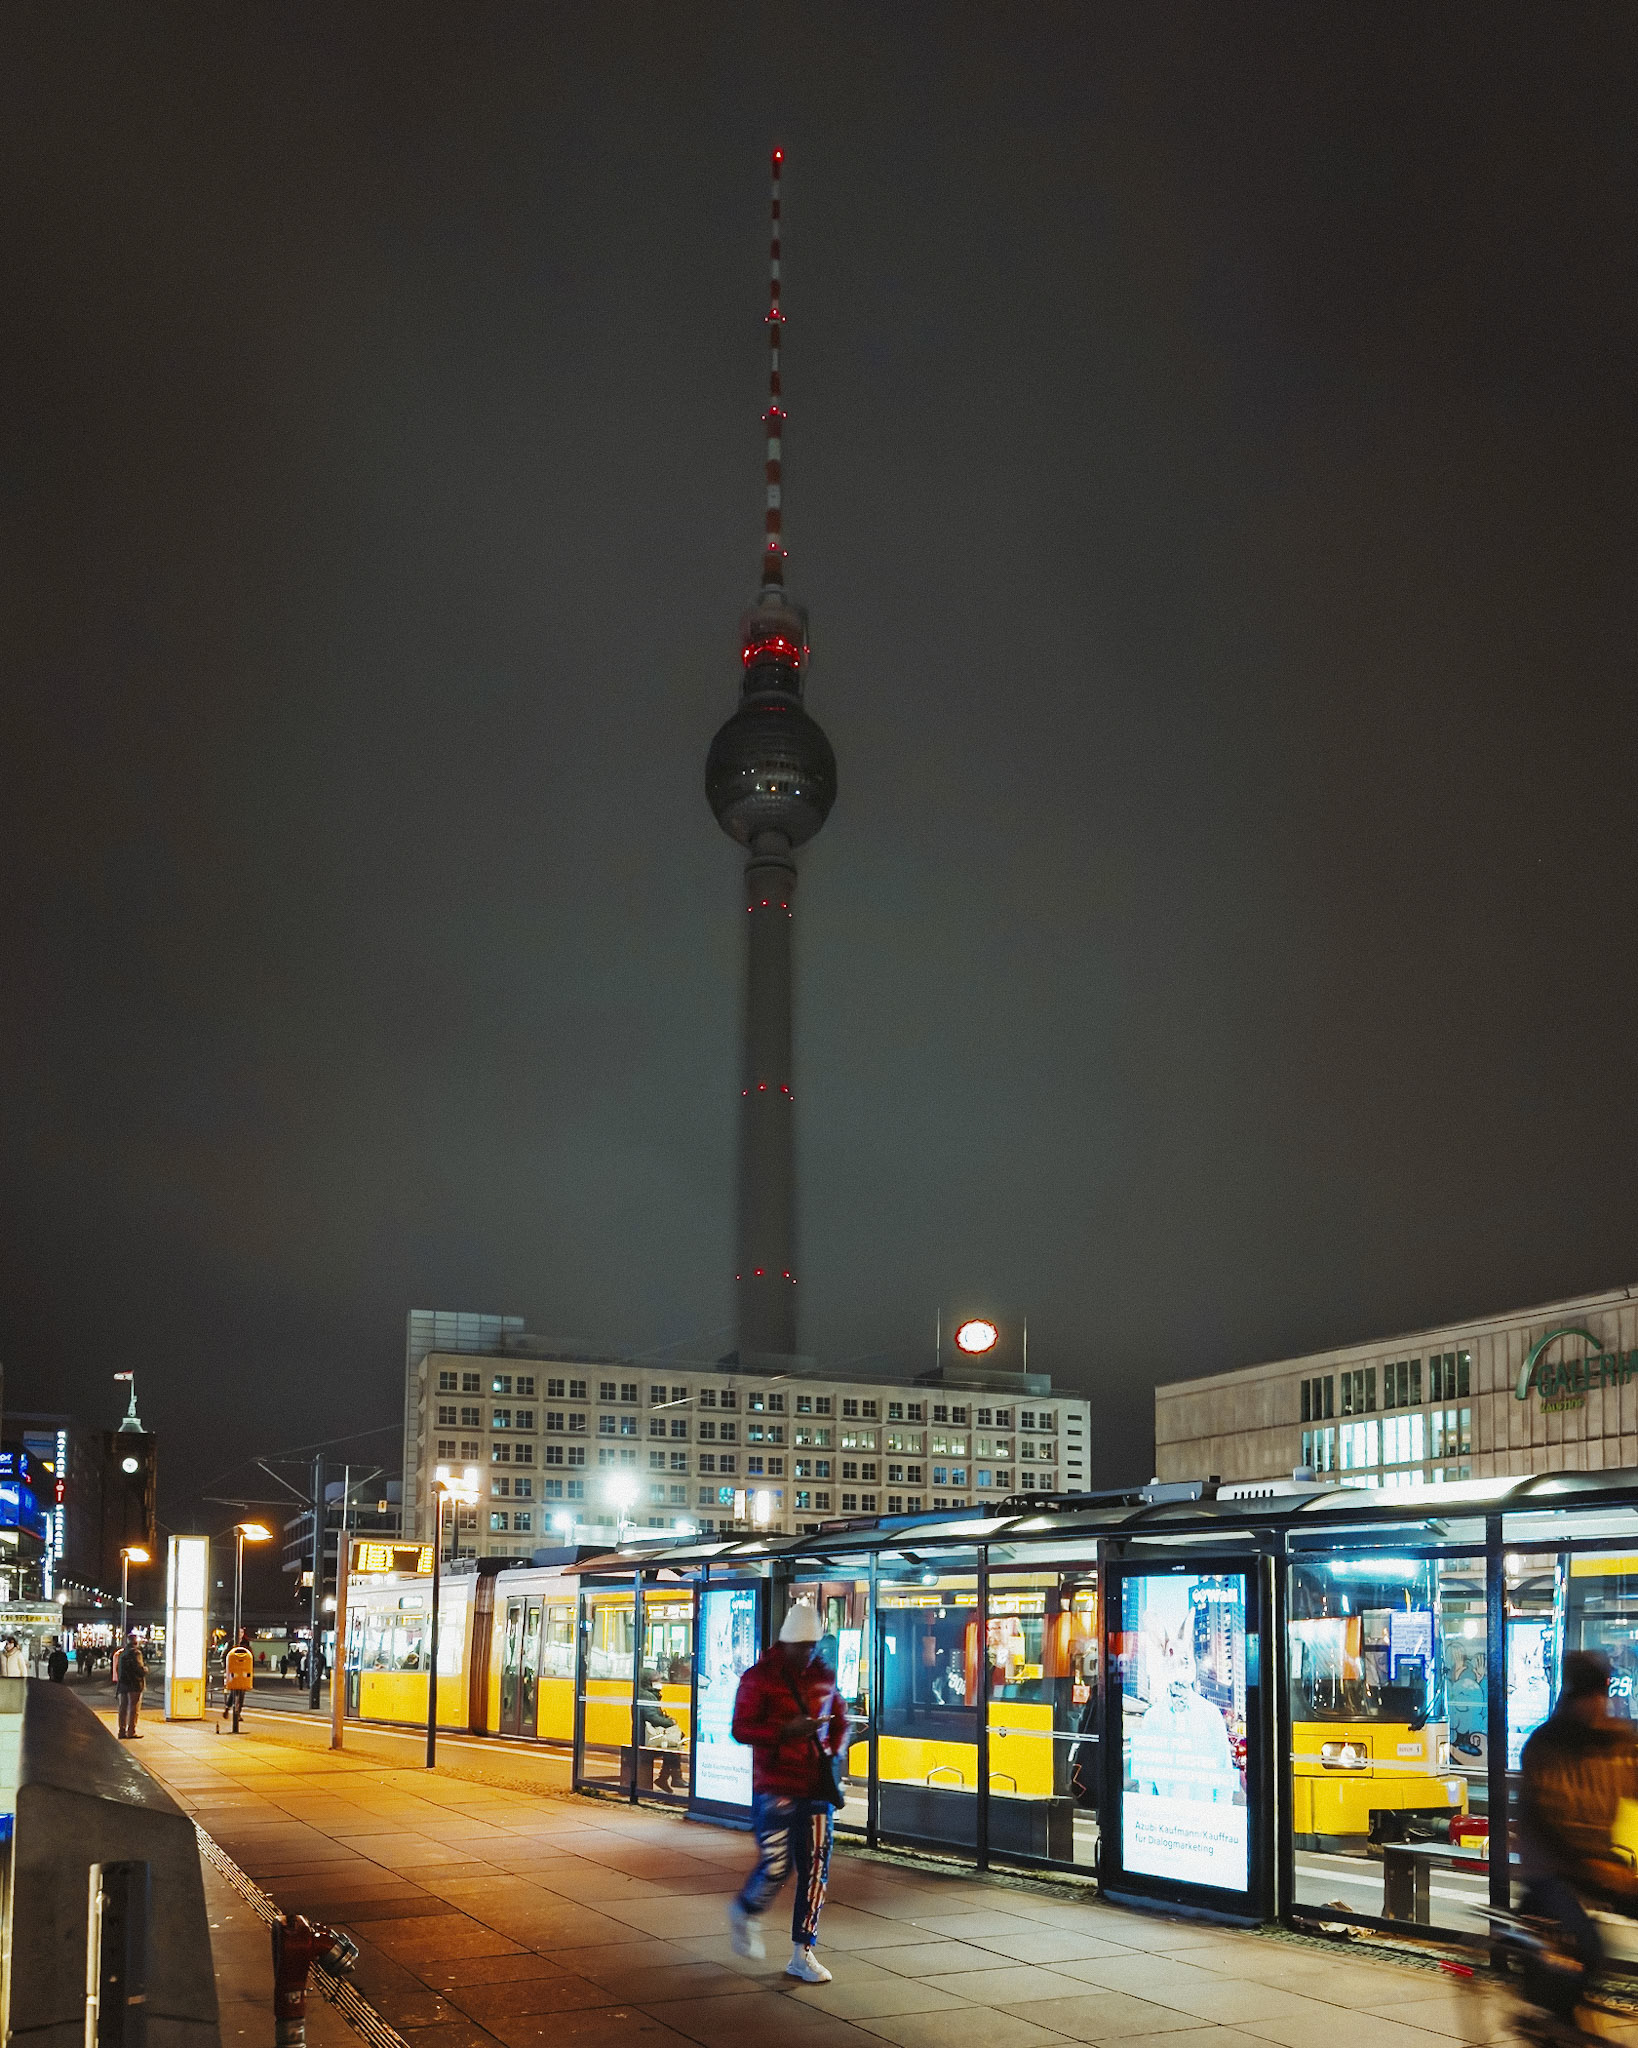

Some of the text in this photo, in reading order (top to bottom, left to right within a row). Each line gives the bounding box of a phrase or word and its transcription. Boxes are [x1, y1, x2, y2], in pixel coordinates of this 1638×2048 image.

[1537, 1348, 1638, 1398] GALERIA
[56, 1430, 66, 1478] RATHAUS
[1147, 1835, 1215, 1857] Dialogmarketing
